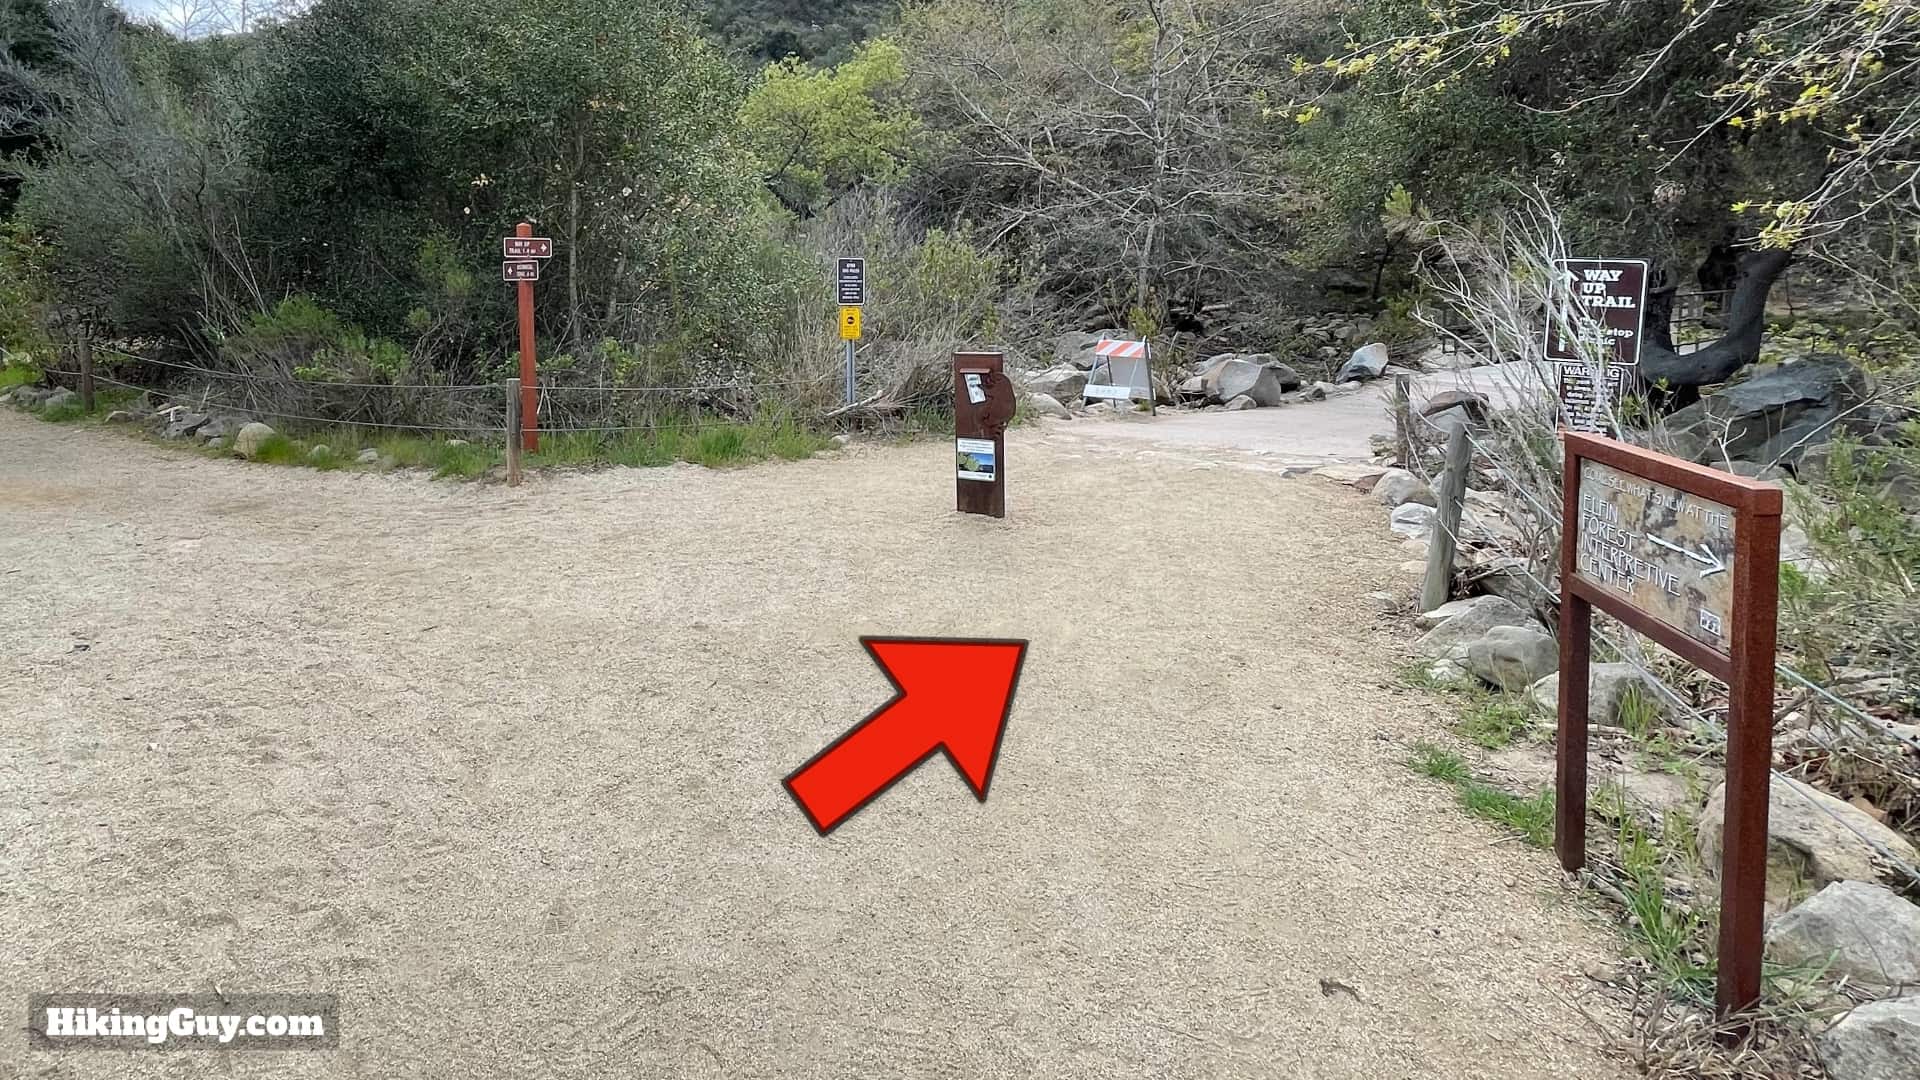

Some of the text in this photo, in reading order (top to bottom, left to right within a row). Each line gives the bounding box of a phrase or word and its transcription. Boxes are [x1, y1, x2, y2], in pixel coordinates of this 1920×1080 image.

[1582, 282, 1607, 294] UP
[1583, 269, 1623, 282] WAY
[1581, 295, 1636, 308] TRAIL
[1583, 494, 1619, 523] ELFIN
[1607, 474, 1628, 493] SEE
[1662, 493, 1688, 513] NEW
[1686, 503, 1705, 521] AT
[1703, 509, 1729, 530] THE
[1582, 512, 1638, 553] FOREST
[1580, 553, 1635, 596] CENTER
[1581, 531, 1681, 598] INTERPRETIVE
